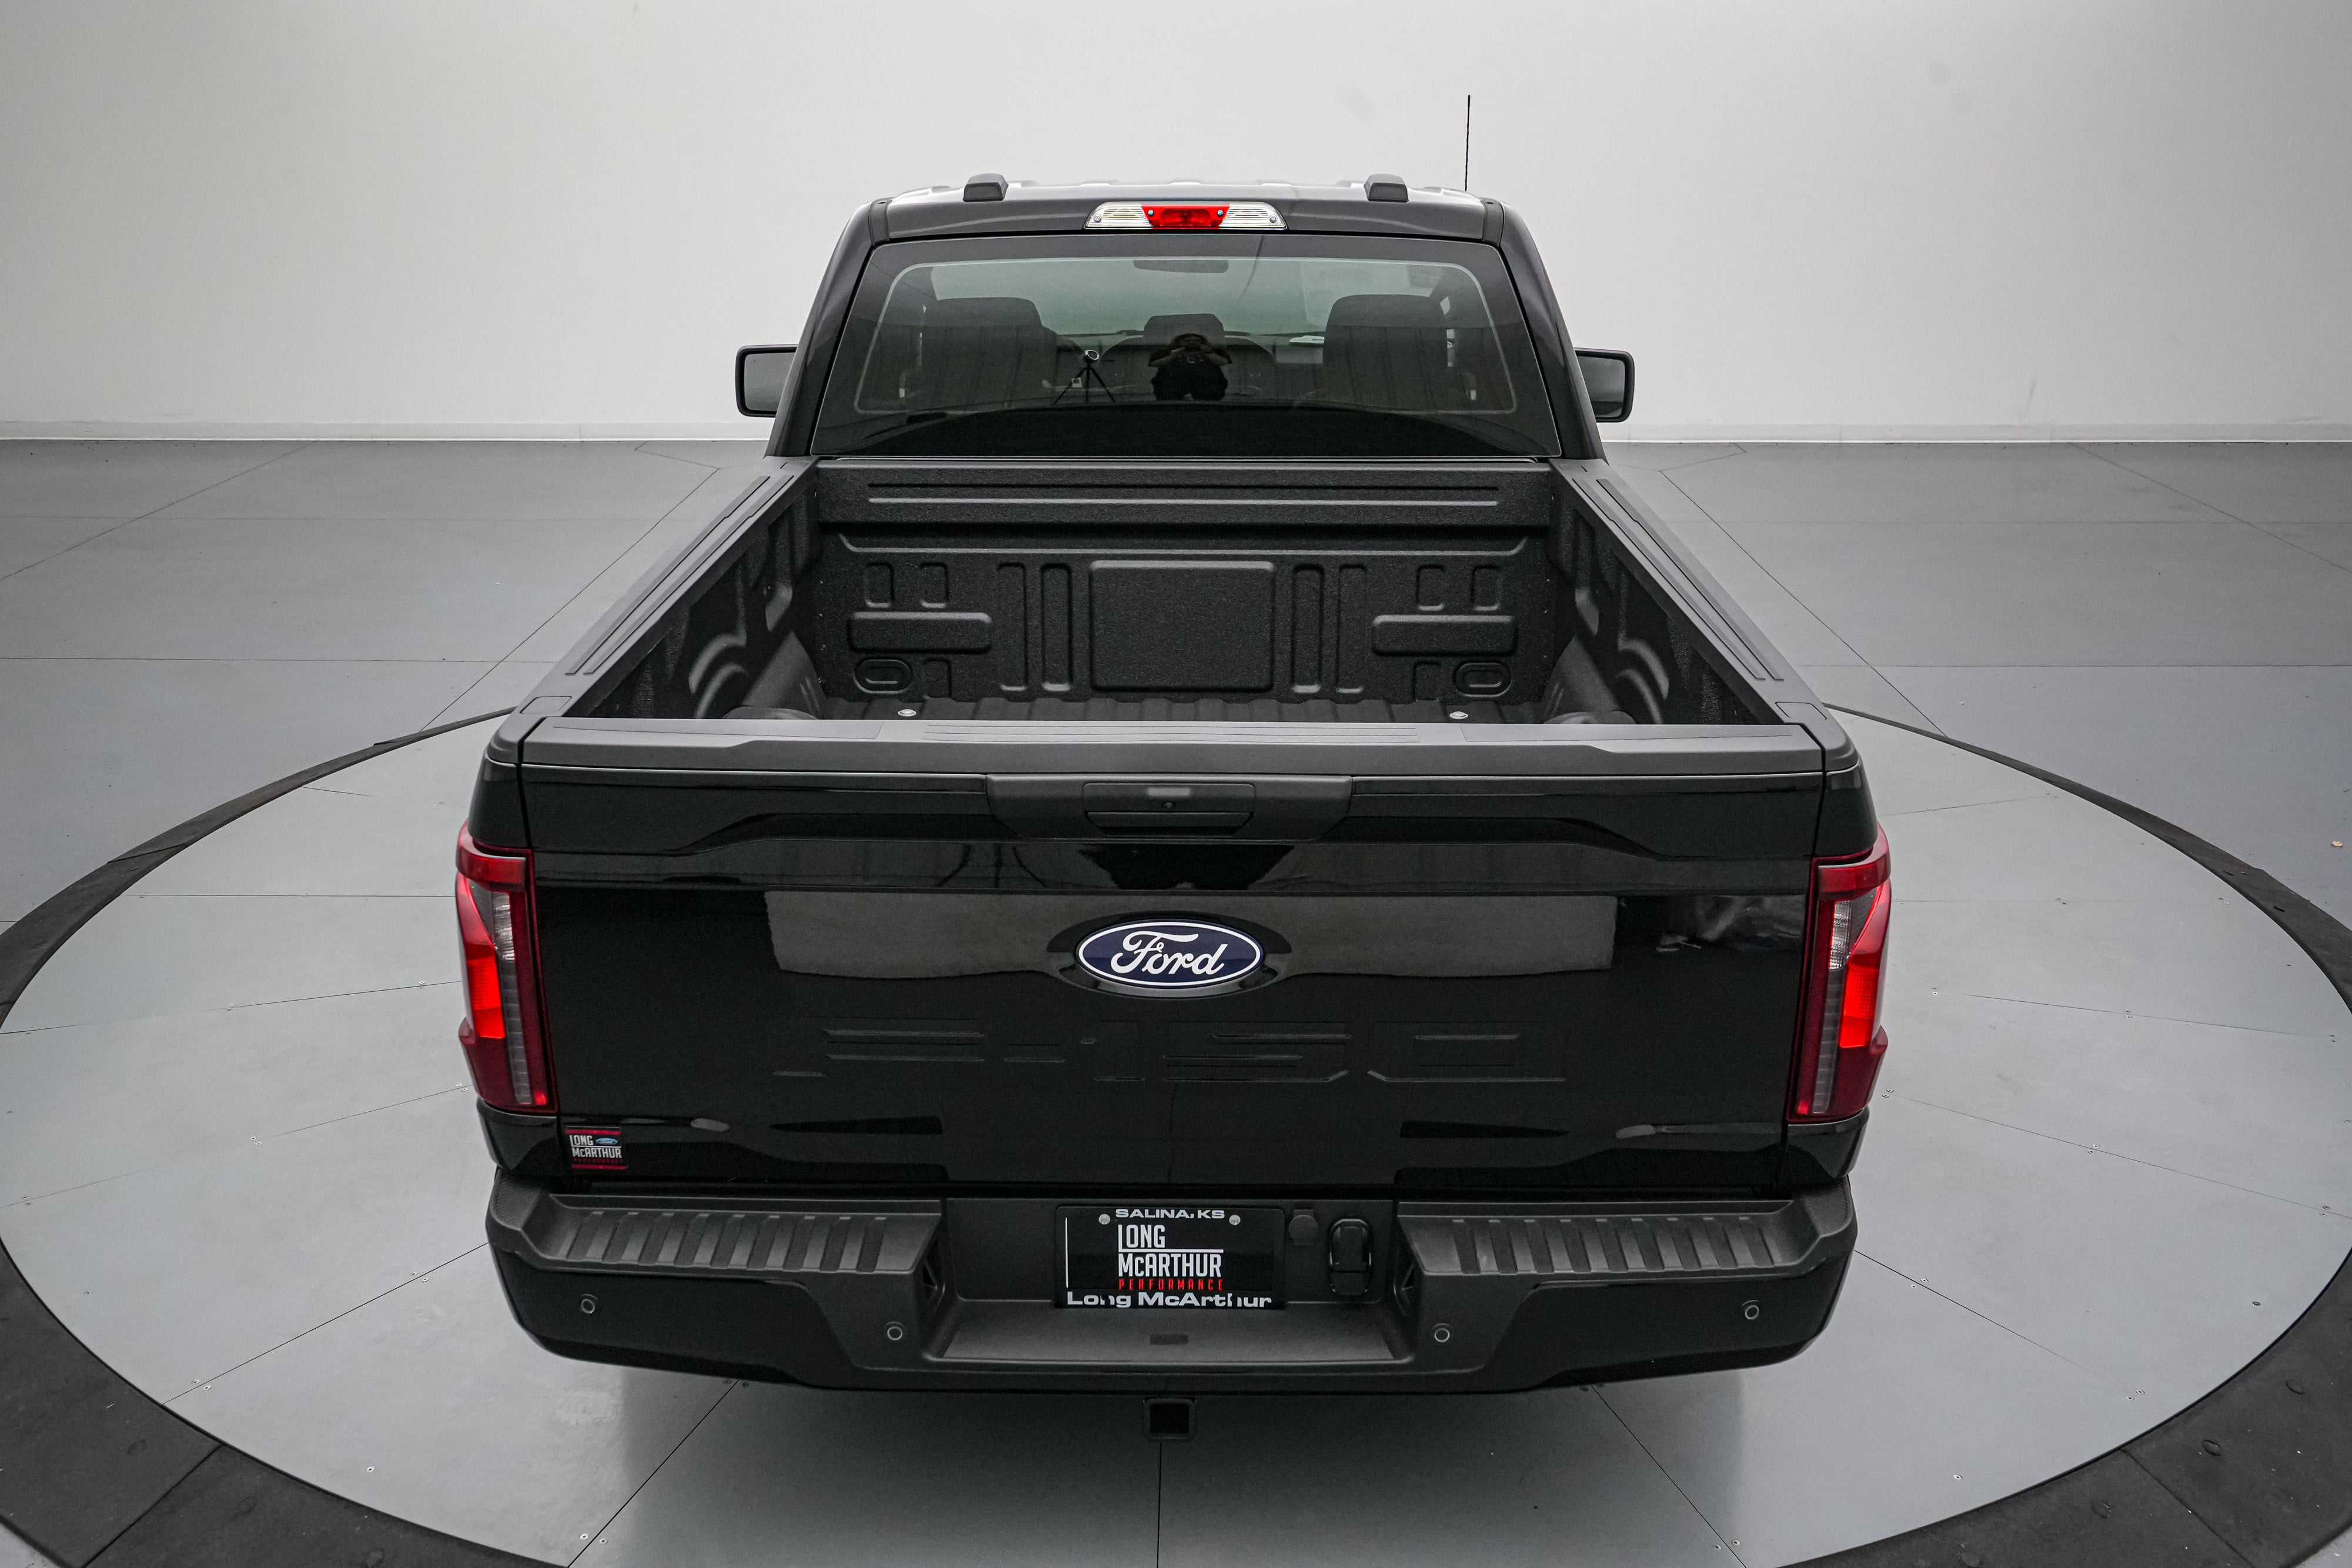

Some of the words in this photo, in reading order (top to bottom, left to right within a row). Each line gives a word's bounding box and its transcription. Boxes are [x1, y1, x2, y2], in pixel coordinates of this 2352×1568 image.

[1110, 931, 1228, 975] Ford
[569, 1135, 593, 1146] LONG
[572, 1147, 622, 1158] McARTHUR
[1115, 1208, 1194, 1219] SALINA,
[1197, 1209, 1225, 1219] KS
[1118, 1224, 1165, 1251] LONG
[1118, 1253, 1222, 1278] McARTHUR
[1118, 1278, 1224, 1290] PERFORMANCE
